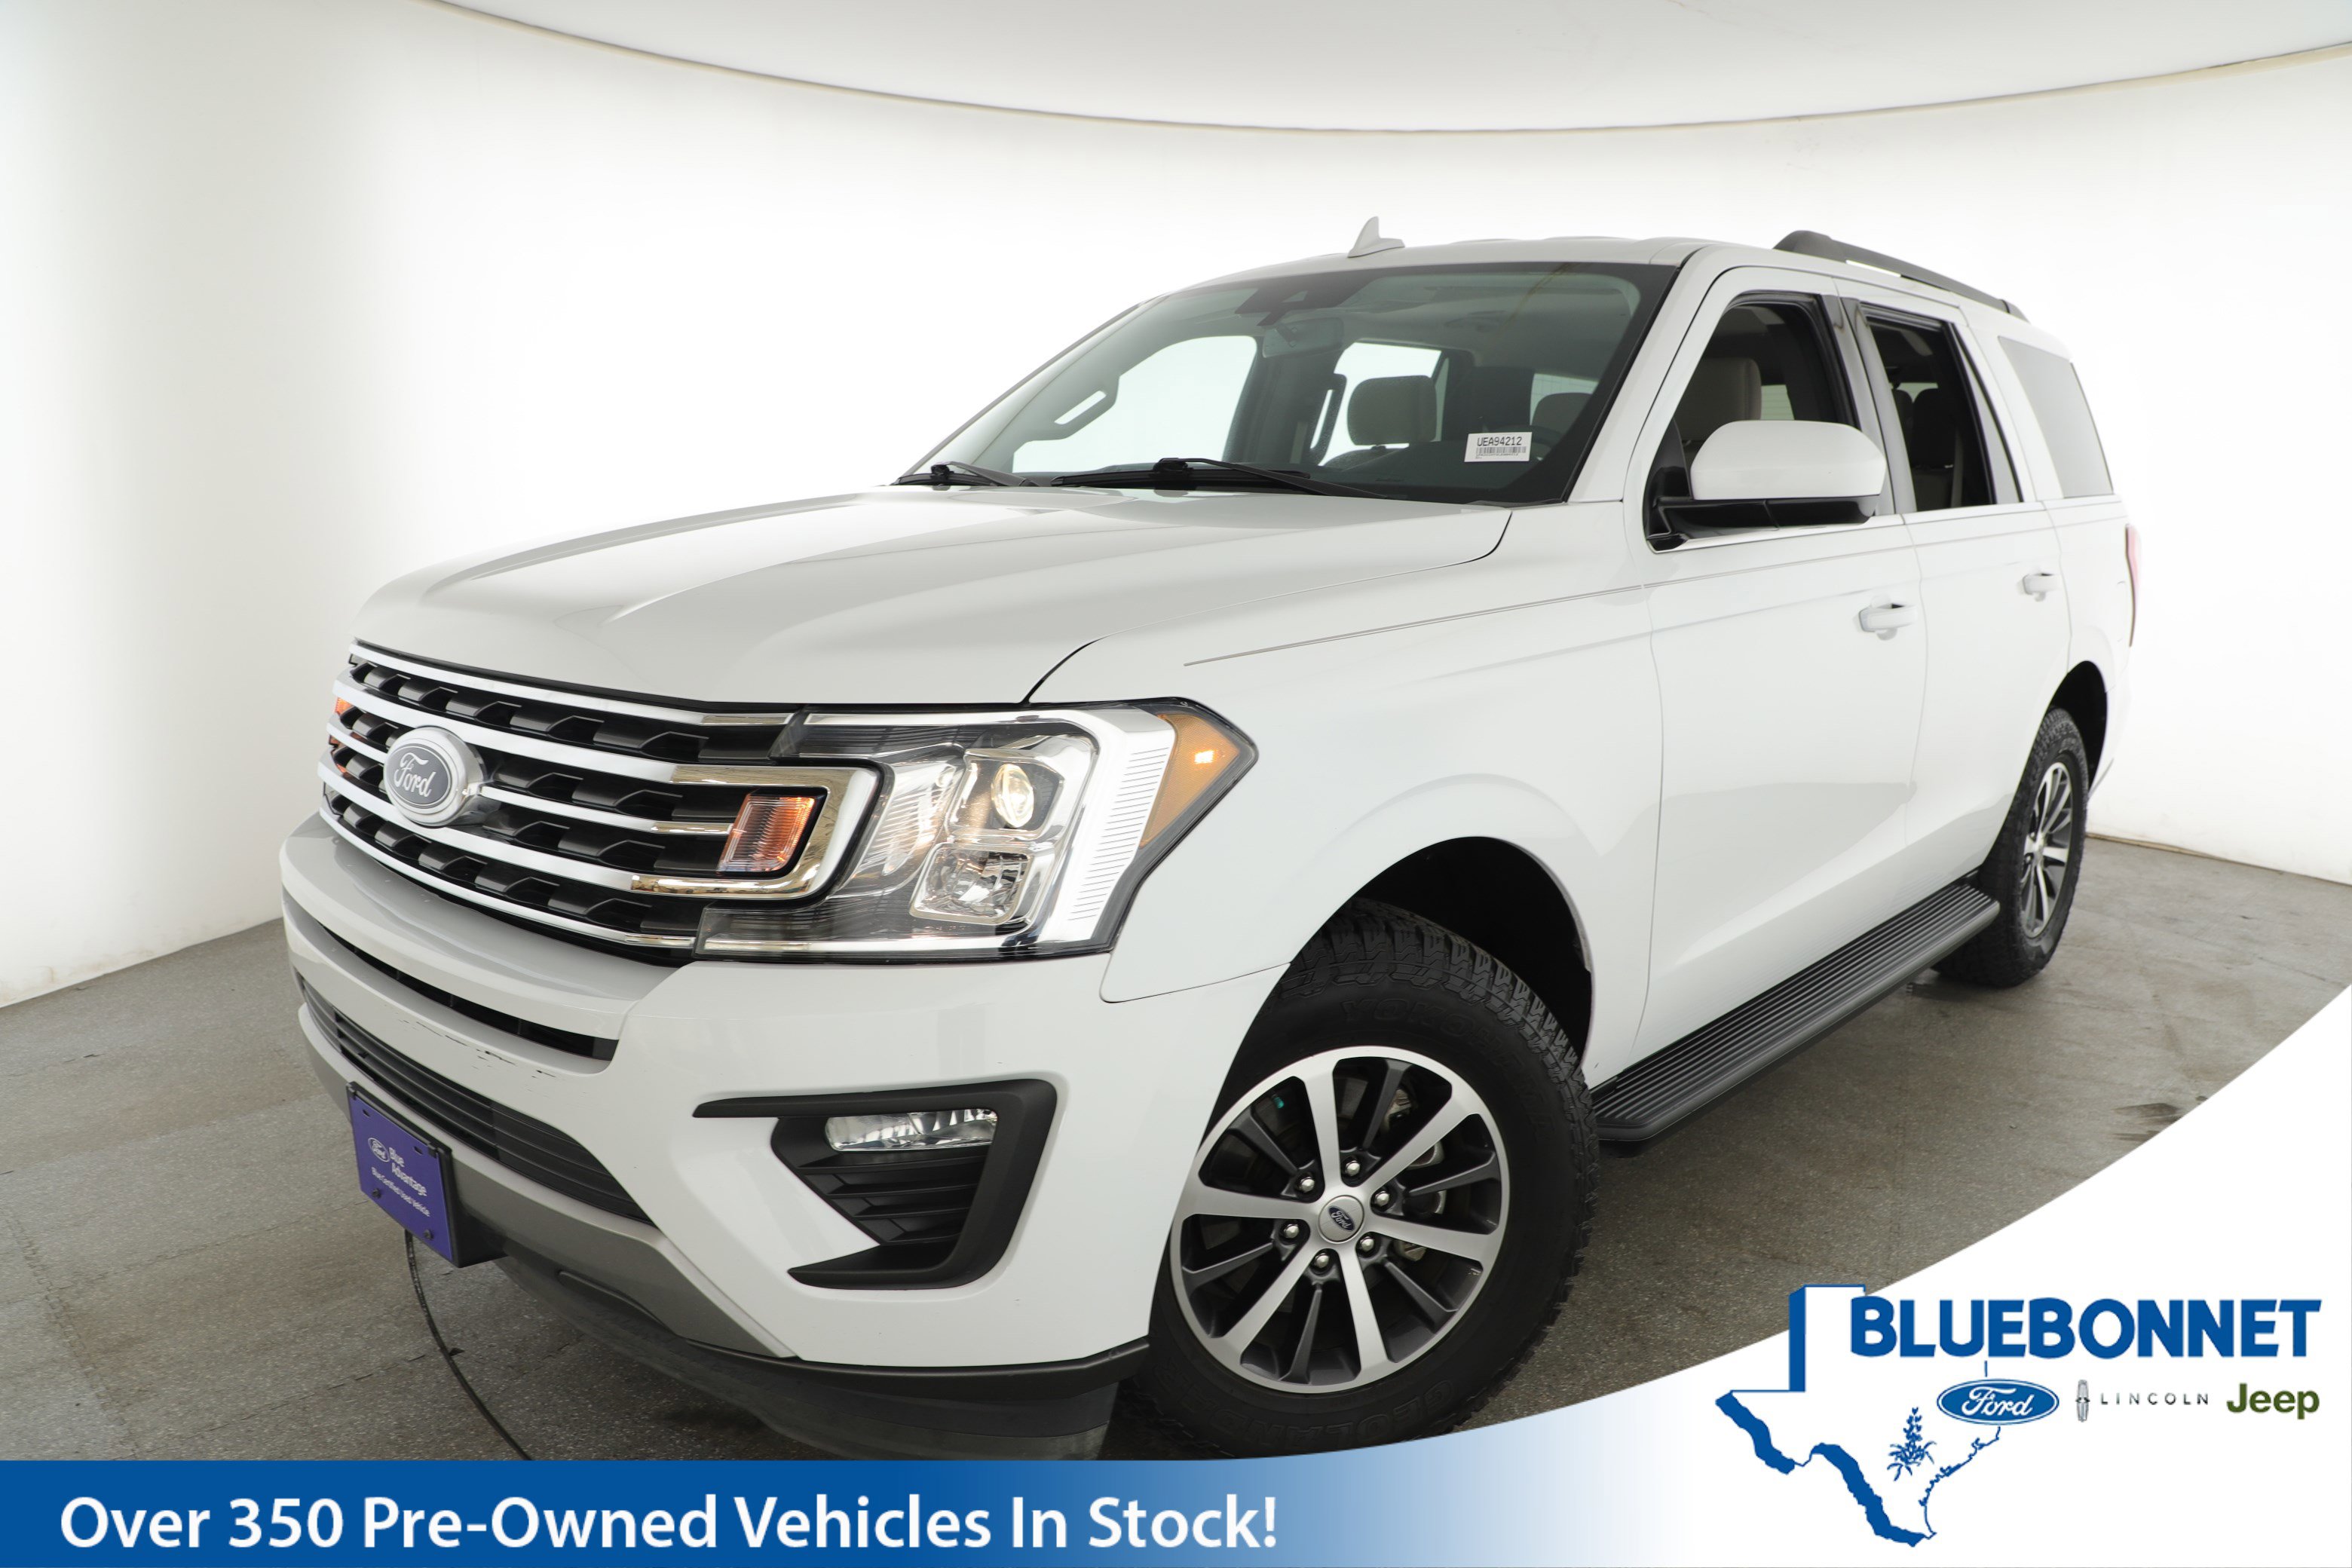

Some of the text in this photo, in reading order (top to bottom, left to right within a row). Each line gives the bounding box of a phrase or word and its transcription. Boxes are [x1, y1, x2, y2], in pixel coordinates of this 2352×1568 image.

[1477, 436, 1522, 446] UEA94212
[394, 752, 436, 798] Ford
[372, 1140, 386, 1159] Ford
[389, 1147, 405, 1168] Blue
[392, 1162, 427, 1197] Advantage
[1331, 1210, 1352, 1229] Ford
